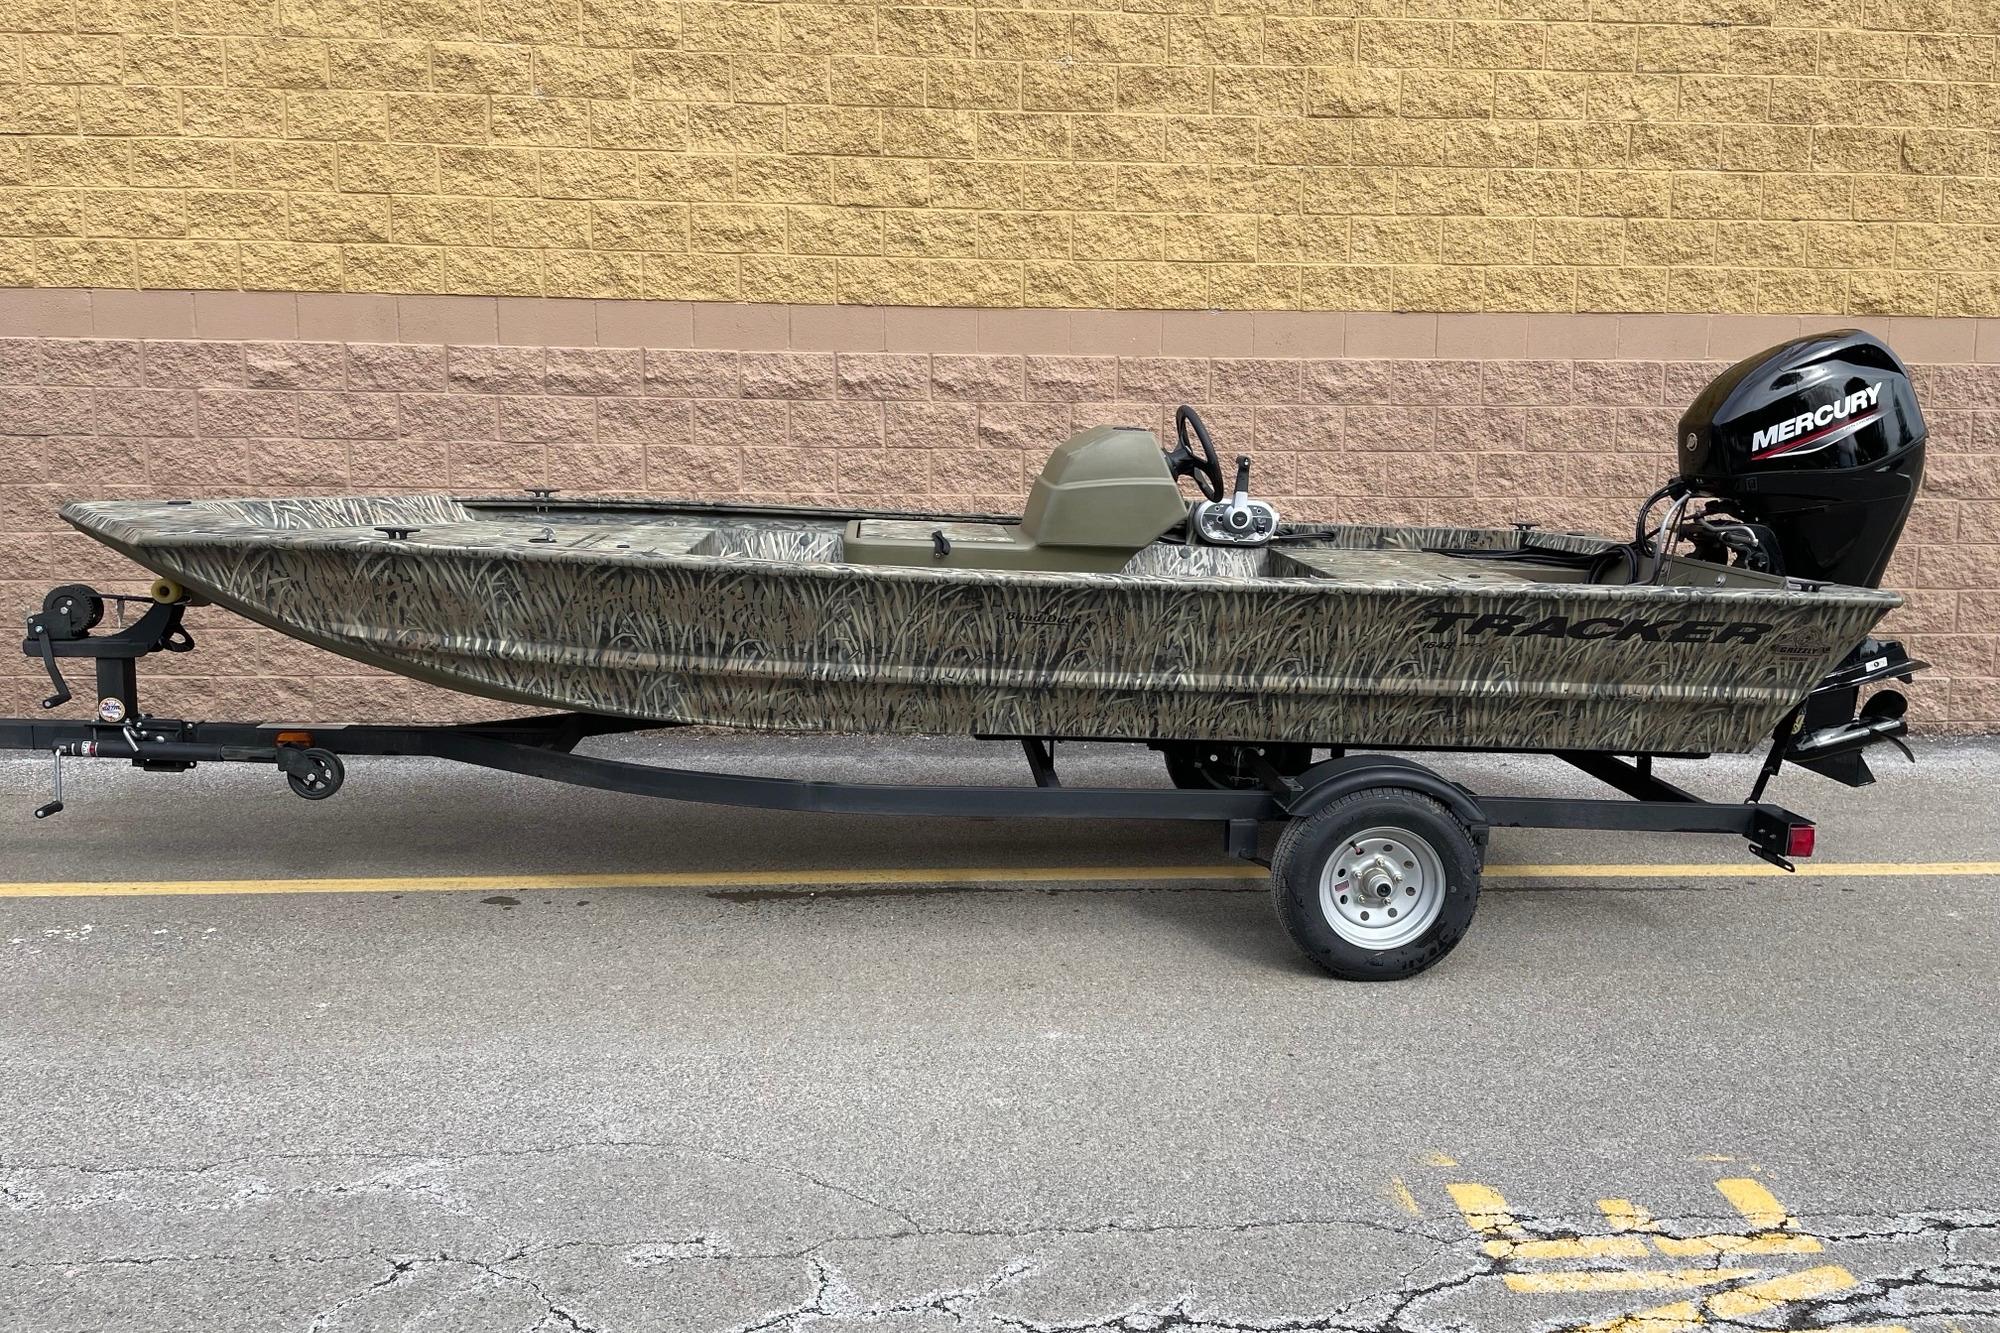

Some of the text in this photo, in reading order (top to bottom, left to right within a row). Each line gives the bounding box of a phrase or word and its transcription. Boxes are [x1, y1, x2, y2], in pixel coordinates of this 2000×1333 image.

[1752, 382, 1882, 452] MERCURY
[1006, 612, 1042, 622] Blind
[1426, 613, 1774, 644] TRACKER
[1423, 641, 1453, 650] 1648
